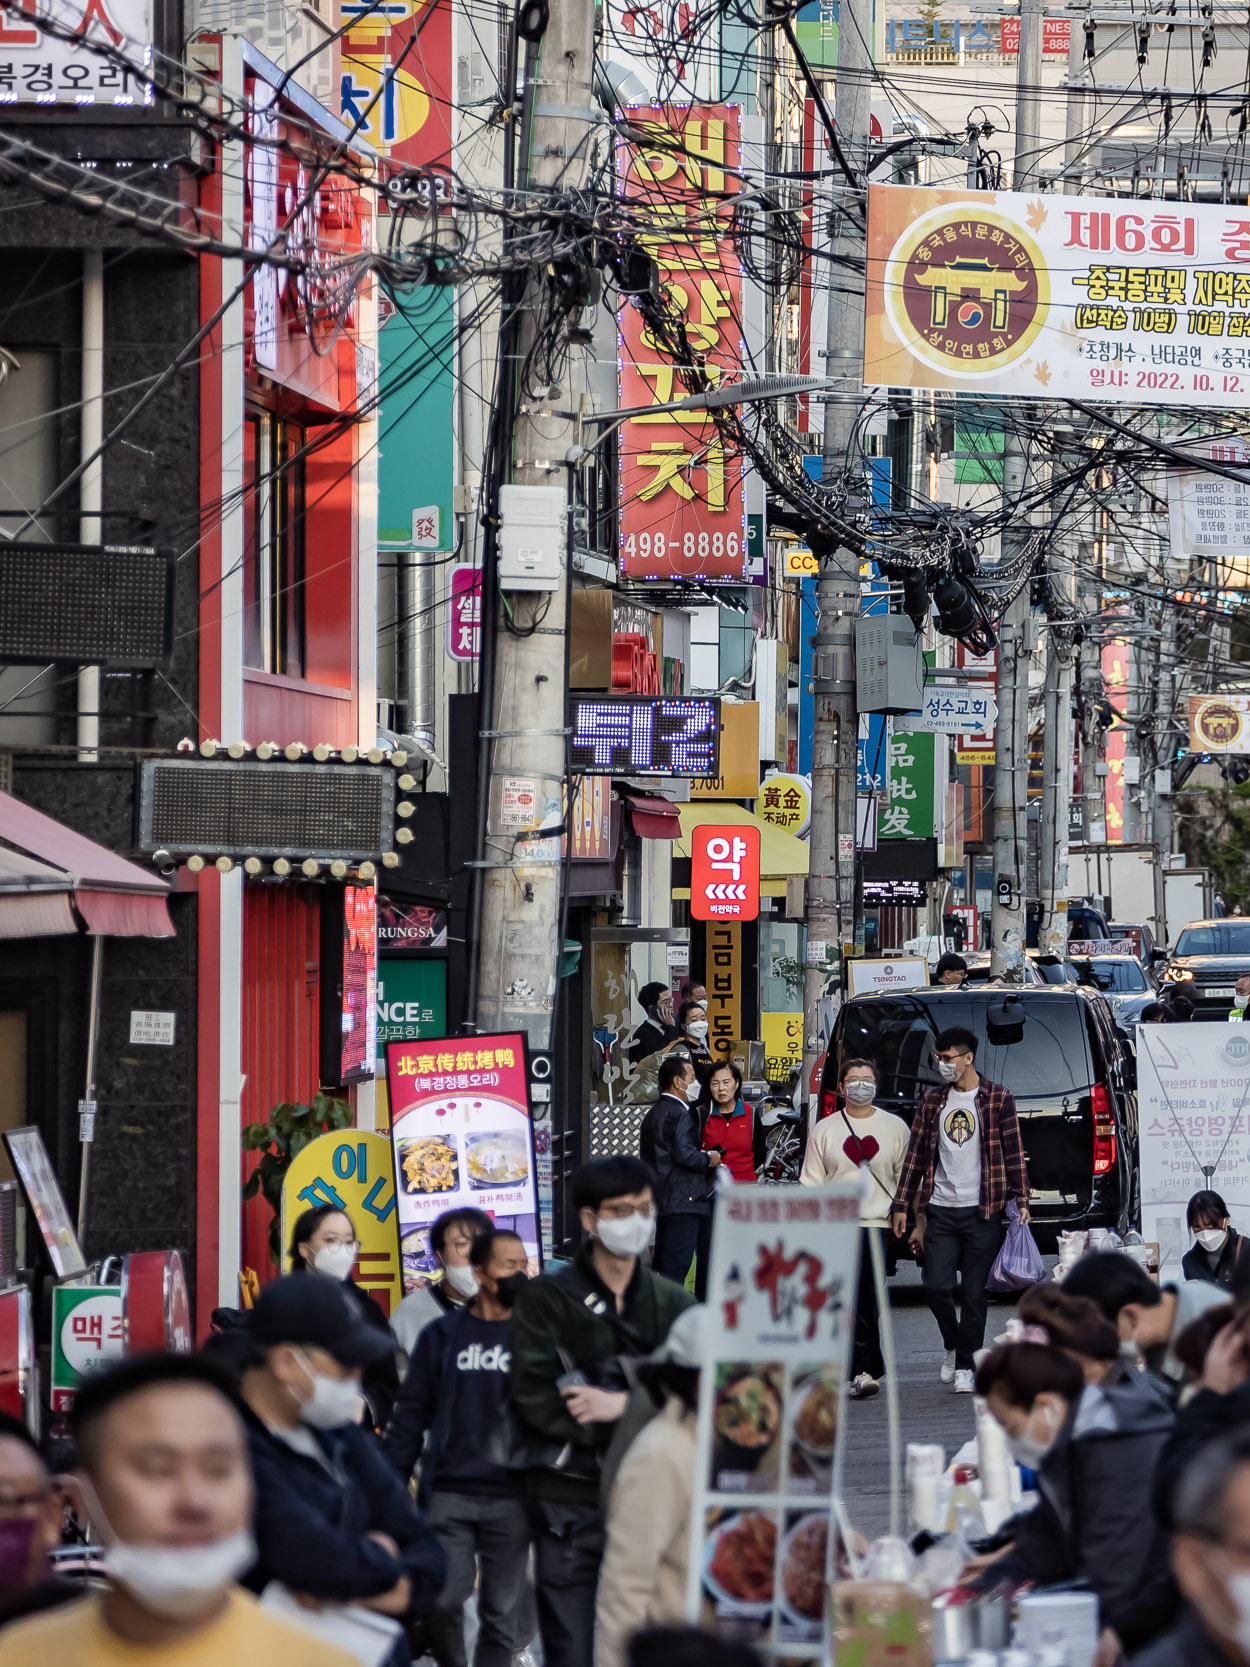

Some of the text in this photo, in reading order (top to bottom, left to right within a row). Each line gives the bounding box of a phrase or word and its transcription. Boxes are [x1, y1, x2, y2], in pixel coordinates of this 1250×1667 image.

[1063, 211, 1196, 257] 제6회
[1133, 308, 1176, 333] 10명)
[1187, 310, 1225, 335] 10일
[928, 331, 1007, 358] 상인연합회
[1151, 343, 1202, 367] 난타공연
[1089, 368, 1129, 387] 일시:
[1136, 371, 1185, 390] 2022.
[1193, 374, 1215, 392] 10.
[1223, 375, 1245, 393] 12.
[624, 531, 739, 560] 498-8886
[926, 698, 988, 718] 성수교회
[879, 731, 917, 835] 品批发
[763, 787, 802, 810] 黃金
[763, 812, 800, 827] 不动产
[706, 836, 748, 881] 약
[710, 904, 741, 915] 비전약국
[378, 927, 436, 938] RUNGSA
[711, 921, 735, 1062] 금부동
[872, 975, 907, 983] TSINGTAO
[397, 1048, 515, 1077] 北京传统烤鸭
[414, 1072, 499, 1093] (북경정통오리)
